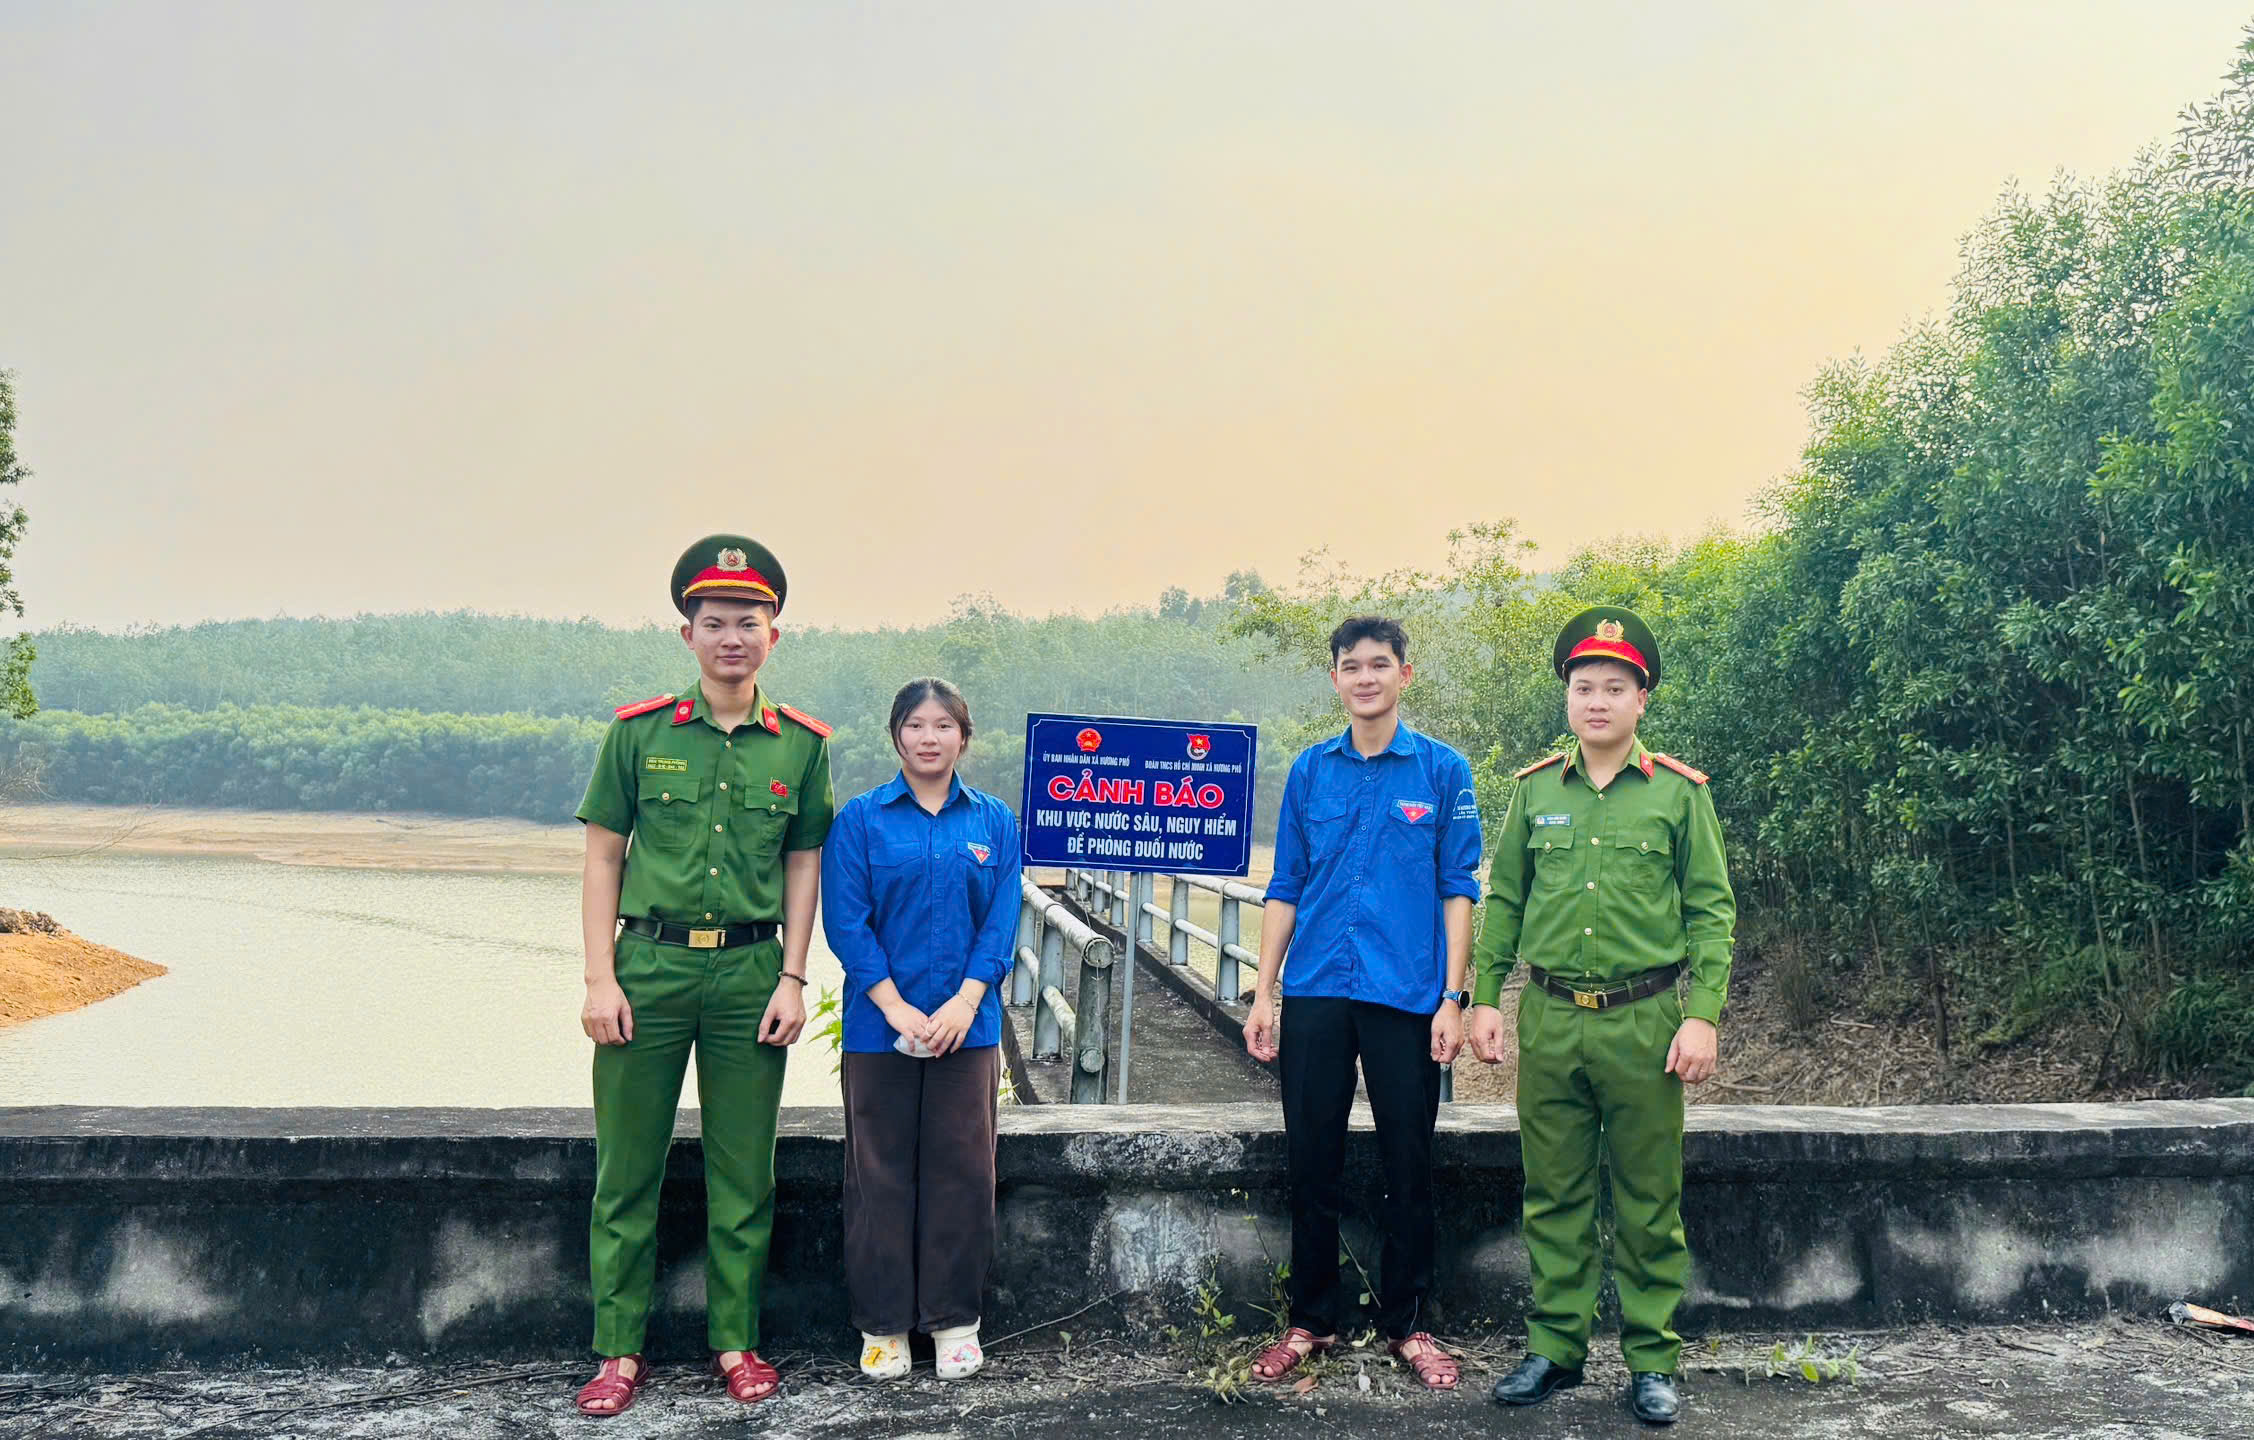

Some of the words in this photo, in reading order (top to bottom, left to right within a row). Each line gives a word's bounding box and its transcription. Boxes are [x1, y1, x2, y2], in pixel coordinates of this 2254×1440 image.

[1051, 753, 1063, 763] BAN
[1064, 753, 1078, 764] NHÂN
[1079, 754, 1090, 765] DÂN
[1160, 761, 1173, 770] TNCS
[1182, 761, 1190, 771] CHÍ
[1191, 762, 1205, 772] MINH
[1048, 768, 1145, 805] CẢNH
[1154, 775, 1224, 809] BÁO
[1036, 809, 1063, 827] KHU
[1066, 811, 1091, 831] VỰC
[1094, 811, 1130, 831] NƯỚC
[1134, 812, 1162, 834] SÂU,
[1167, 817, 1200, 835] NGUY
[1204, 813, 1237, 836] HIỂM
[1067, 832, 1085, 854] ĐỀ
[1088, 835, 1131, 857] PHÒNG
[1135, 836, 1165, 859] ĐUỐI
[1169, 839, 1204, 860] NƯỚC
